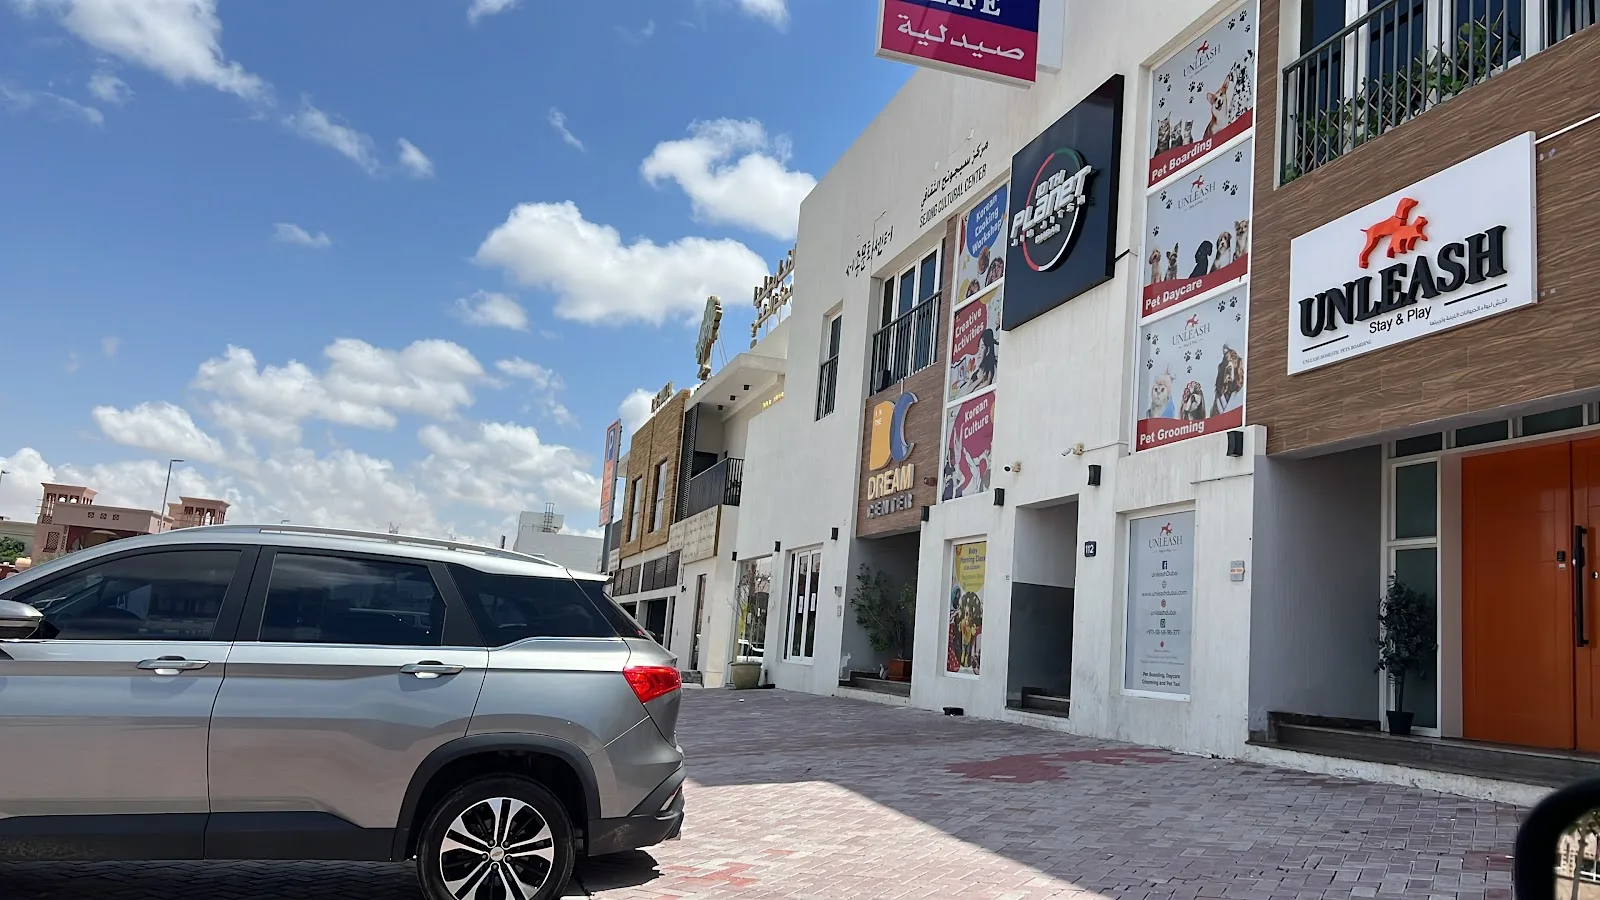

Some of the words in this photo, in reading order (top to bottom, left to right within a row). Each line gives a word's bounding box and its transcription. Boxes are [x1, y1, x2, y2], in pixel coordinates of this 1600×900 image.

[1183, 43, 1221, 77] UNLEASH
[1151, 165, 1168, 181] Pet
[1169, 138, 1212, 171] Boarding
[919, 204, 938, 228] SEJONG
[937, 181, 964, 213] CULTURAL
[964, 163, 987, 192] CENTER
[975, 194, 998, 222] Korean
[1177, 182, 1217, 210] UNLEASH
[971, 217, 1003, 255] Workshop
[974, 207, 999, 238] Cooking
[1145, 297, 1161, 311] Pet
[1162, 279, 1203, 301] Daycare
[1298, 224, 1508, 338] UNLEASH
[954, 307, 982, 339] Creative
[1172, 323, 1211, 346] UNLEASH
[1369, 317, 1393, 334] Stay
[1396, 313, 1404, 326] &
[1407, 306, 1432, 323] Play
[953, 321, 985, 356] Activities
[964, 398, 988, 423] Korean
[964, 414, 989, 439] Culture
[1140, 432, 1155, 445] Pet
[1157, 420, 1205, 438] Grooming
[867, 463, 915, 500] DREAM
[866, 493, 913, 519] CENTER
[1148, 535, 1183, 549] UNLEASH
